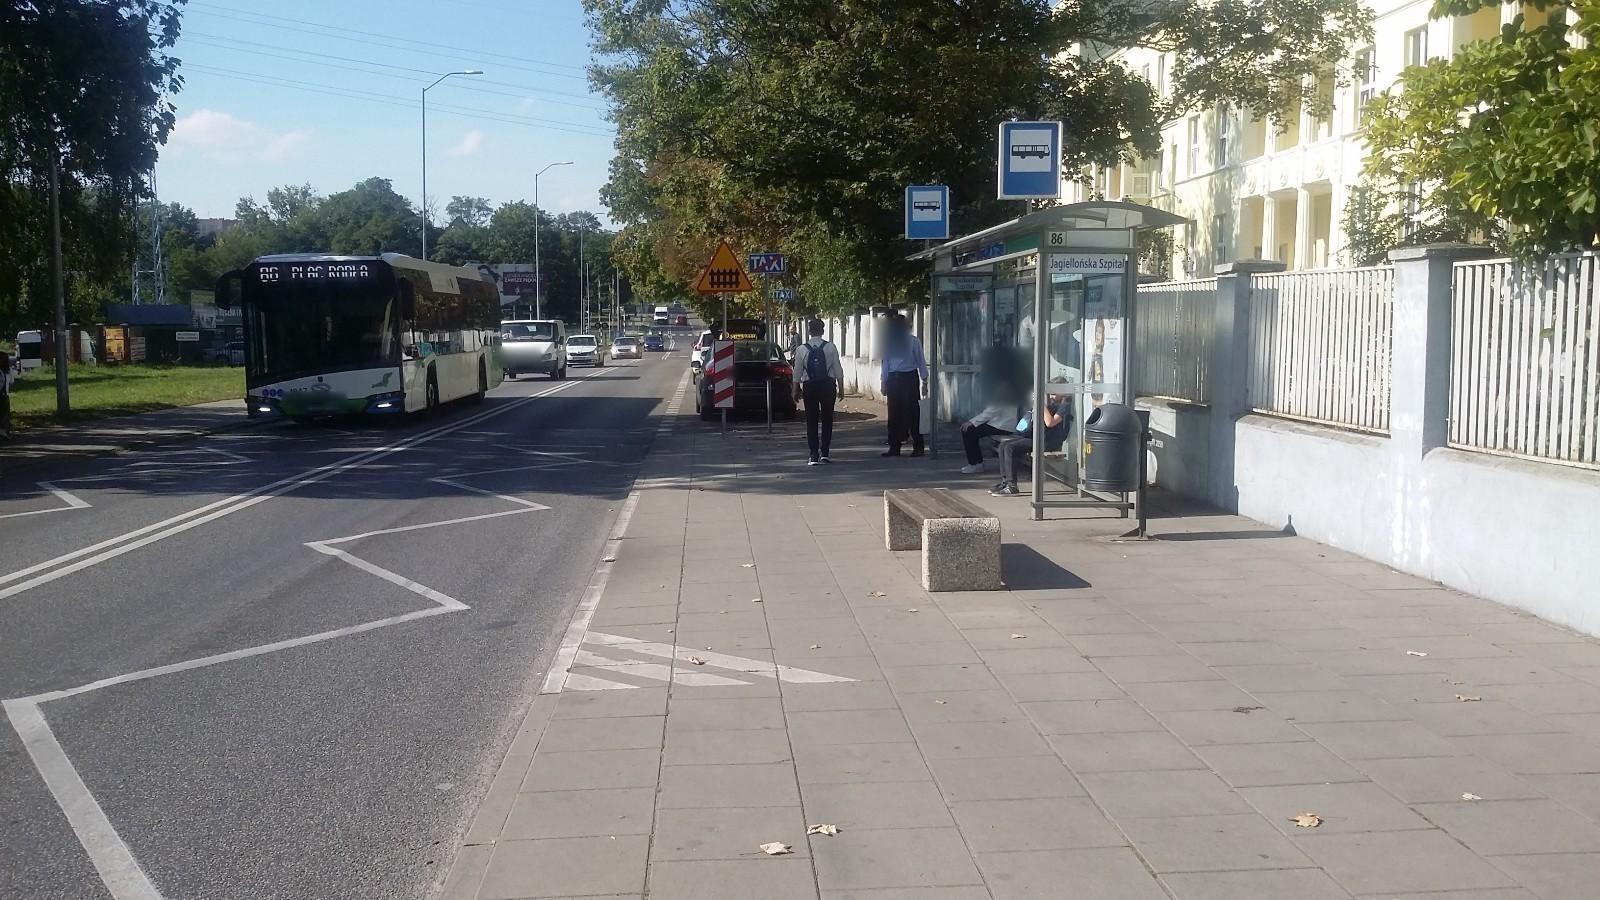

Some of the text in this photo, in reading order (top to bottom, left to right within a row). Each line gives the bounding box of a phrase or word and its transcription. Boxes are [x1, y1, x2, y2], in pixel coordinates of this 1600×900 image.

[1051, 232, 1063, 245] 86
[750, 255, 785, 272] TAXI
[1050, 257, 1125, 271] Jagiellońska Szpital
[775, 290, 794, 300] TAXI
